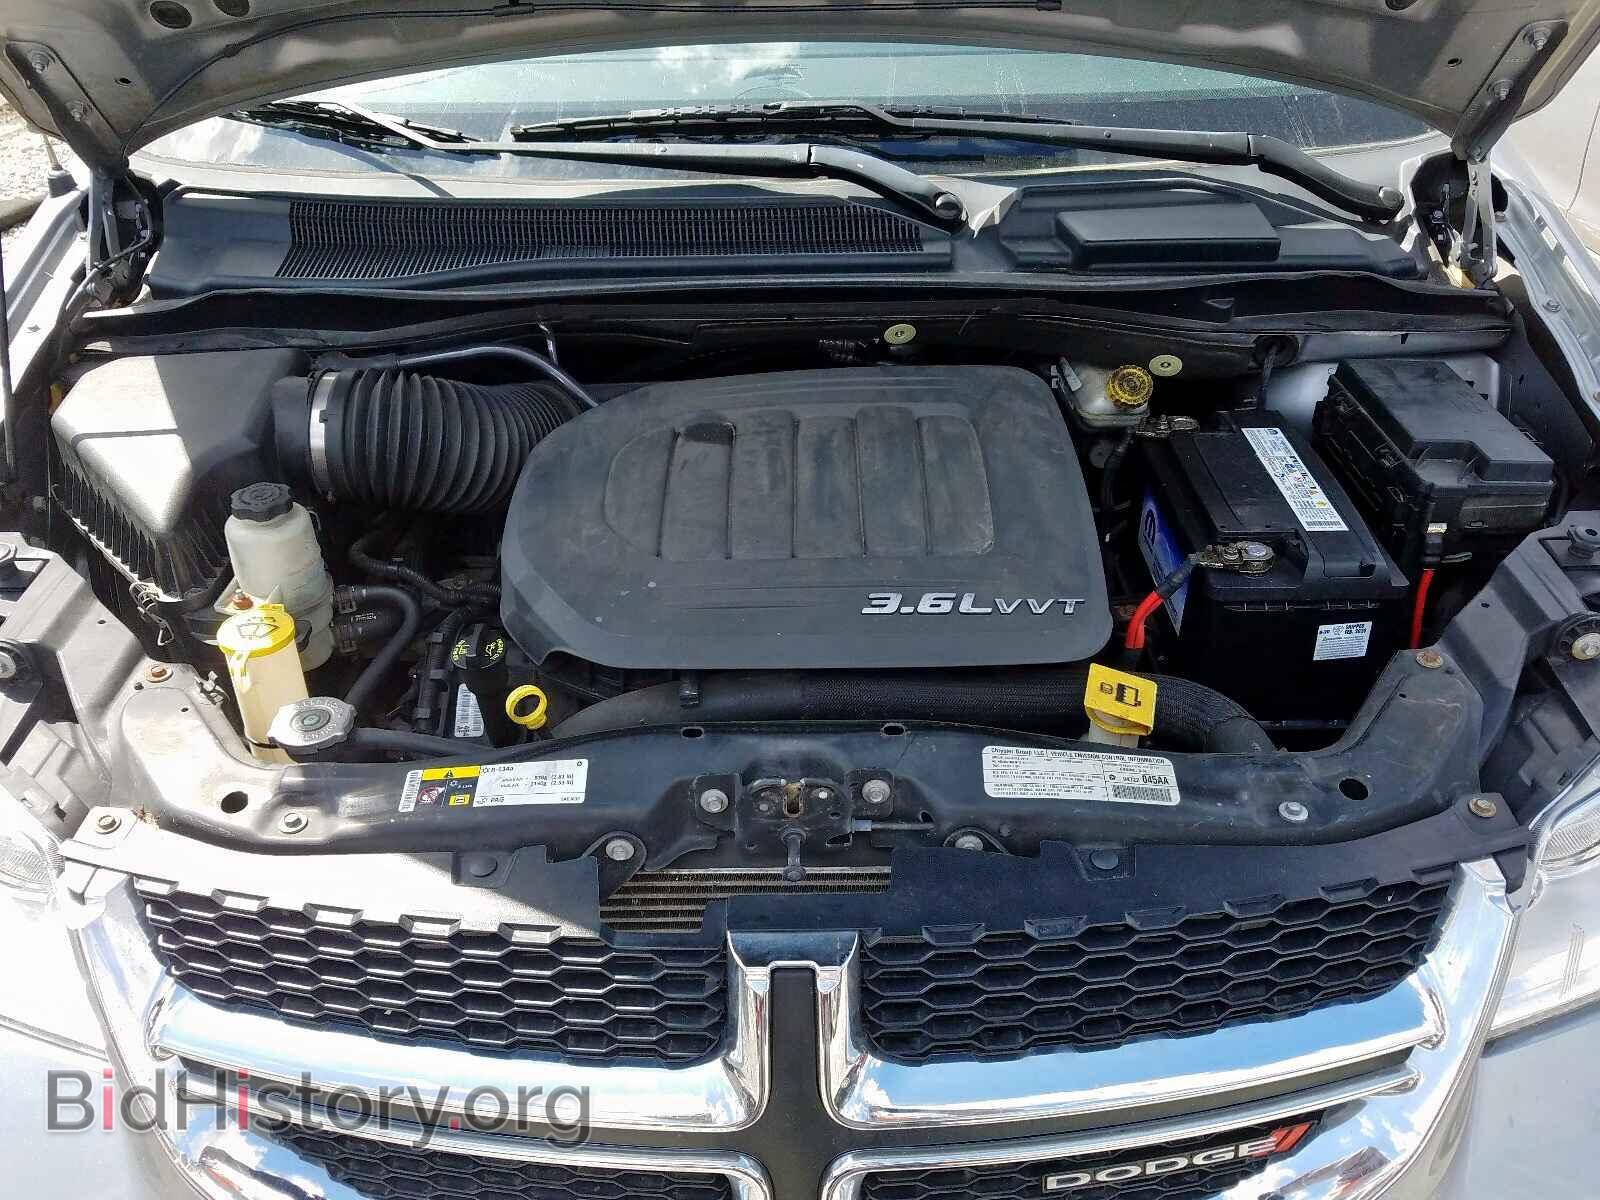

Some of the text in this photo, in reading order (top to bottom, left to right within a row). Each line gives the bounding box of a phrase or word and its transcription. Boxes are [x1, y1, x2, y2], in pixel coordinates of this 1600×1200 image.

[861, 592, 1087, 615] 3.6L VVT
[1046, 1136, 1278, 1190] DODGE
